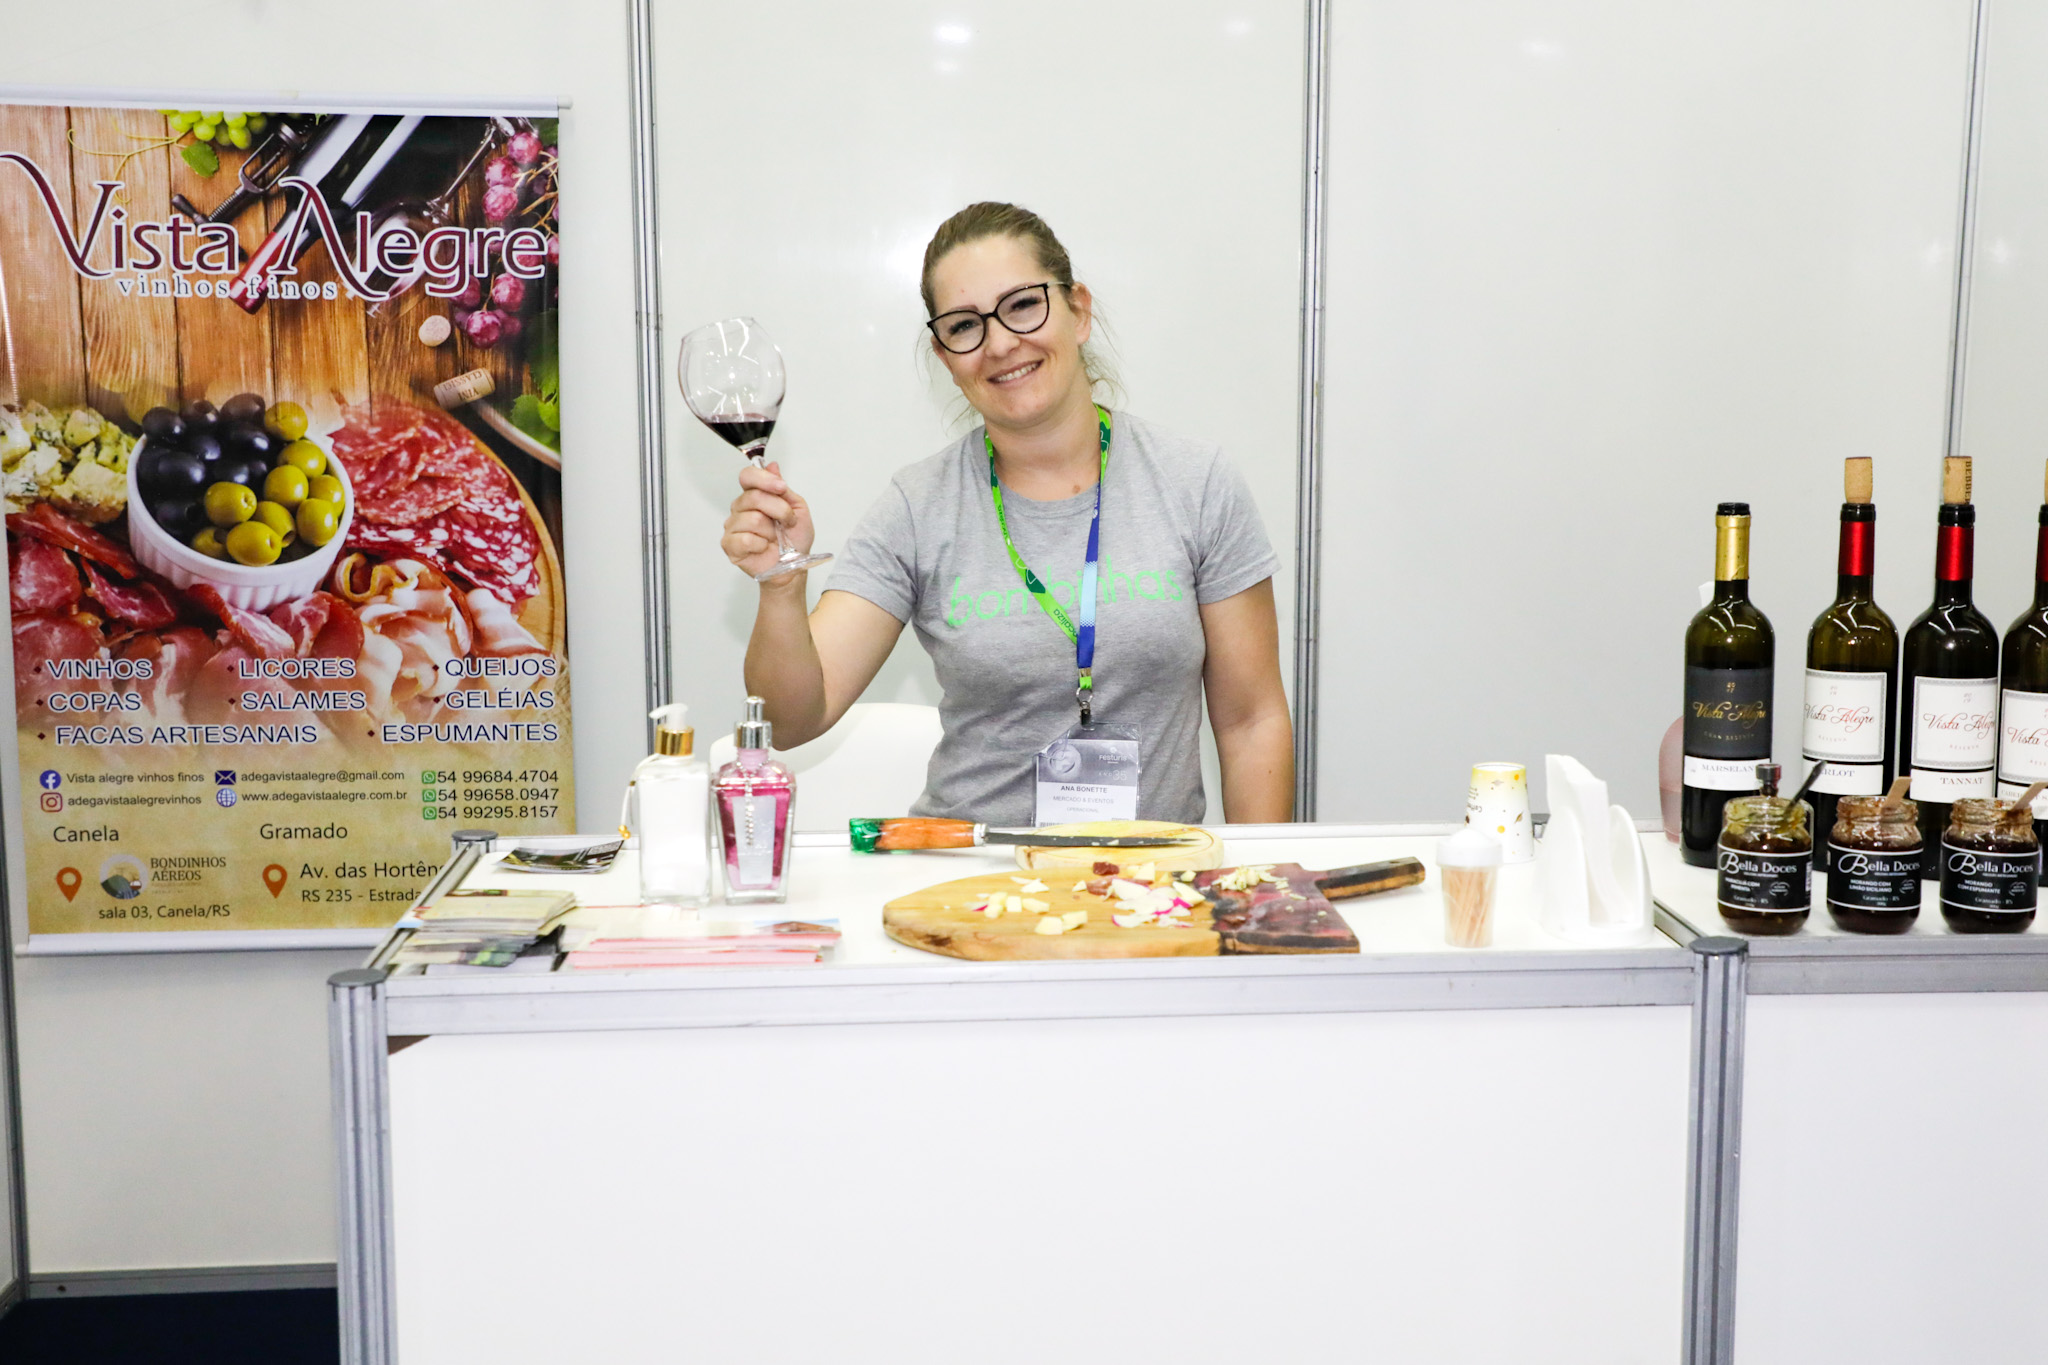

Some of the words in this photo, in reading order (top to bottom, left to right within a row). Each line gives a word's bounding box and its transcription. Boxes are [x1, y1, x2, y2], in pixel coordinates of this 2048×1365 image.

[0, 152, 239, 279] Vista
[269, 177, 548, 301] Alegre
[116, 274, 230, 297] vinhos
[247, 274, 338, 299] finos
[46, 659, 152, 679] VINHOS
[239, 658, 356, 678] LICORES
[445, 658, 557, 678] QUEIJOS
[48, 692, 142, 712] COPAS
[241, 691, 366, 711] SALAMES
[445, 687, 555, 709] GELÉIAS
[1692, 701, 1732, 719] Vista
[1804, 703, 1834, 721] Vista
[1831, 706, 1875, 733] Alegre
[1923, 712, 1968, 729] Vista
[56, 726, 144, 745] FACAS
[150, 725, 318, 745] ARTESANAIS
[382, 723, 559, 743] ESPUMANTES
[241, 770, 405, 783] adegavistaalegre@gmail.com
[437, 771, 457, 783] 54
[462, 770, 559, 783] 99684.4704
[1700, 764, 1754, 773] MARSELAN
[66, 772, 95, 784] Vista
[98, 772, 134, 785] alegre
[137, 771, 174, 783] vinhos
[177, 771, 205, 783] finos
[1940, 777, 1985, 785] TANNAT
[241, 791, 408, 803] www.adegavistaalegre.com.br
[438, 789, 457, 801] 54
[463, 788, 560, 801] 99658.0947
[1076, 786, 1108, 794] BONETTE
[67, 794, 202, 807] adegavistaalegrevinhos
[438, 806, 457, 819] 54
[463, 806, 559, 819] 99295.8157
[53, 824, 119, 842] Canela
[259, 823, 349, 840] Gramado
[150, 856, 227, 869] BONDINHOS
[300, 863, 328, 878] Av.
[335, 862, 367, 878] das
[1719, 851, 1759, 874] Bella
[1762, 861, 1798, 873] Doces
[1838, 853, 1890, 876] Bella
[1893, 860, 1920, 872] Doces
[1948, 852, 1999, 876] Bella
[2003, 861, 2034, 873] Doces
[151, 867, 202, 882] AÉREOS
[1964, 879, 1993, 888] MORANGO
[302, 889, 320, 902] RS
[326, 889, 352, 902] 235
[99, 906, 126, 919] sala
[131, 906, 152, 920] 03,
[157, 904, 231, 918] Canela/RS
